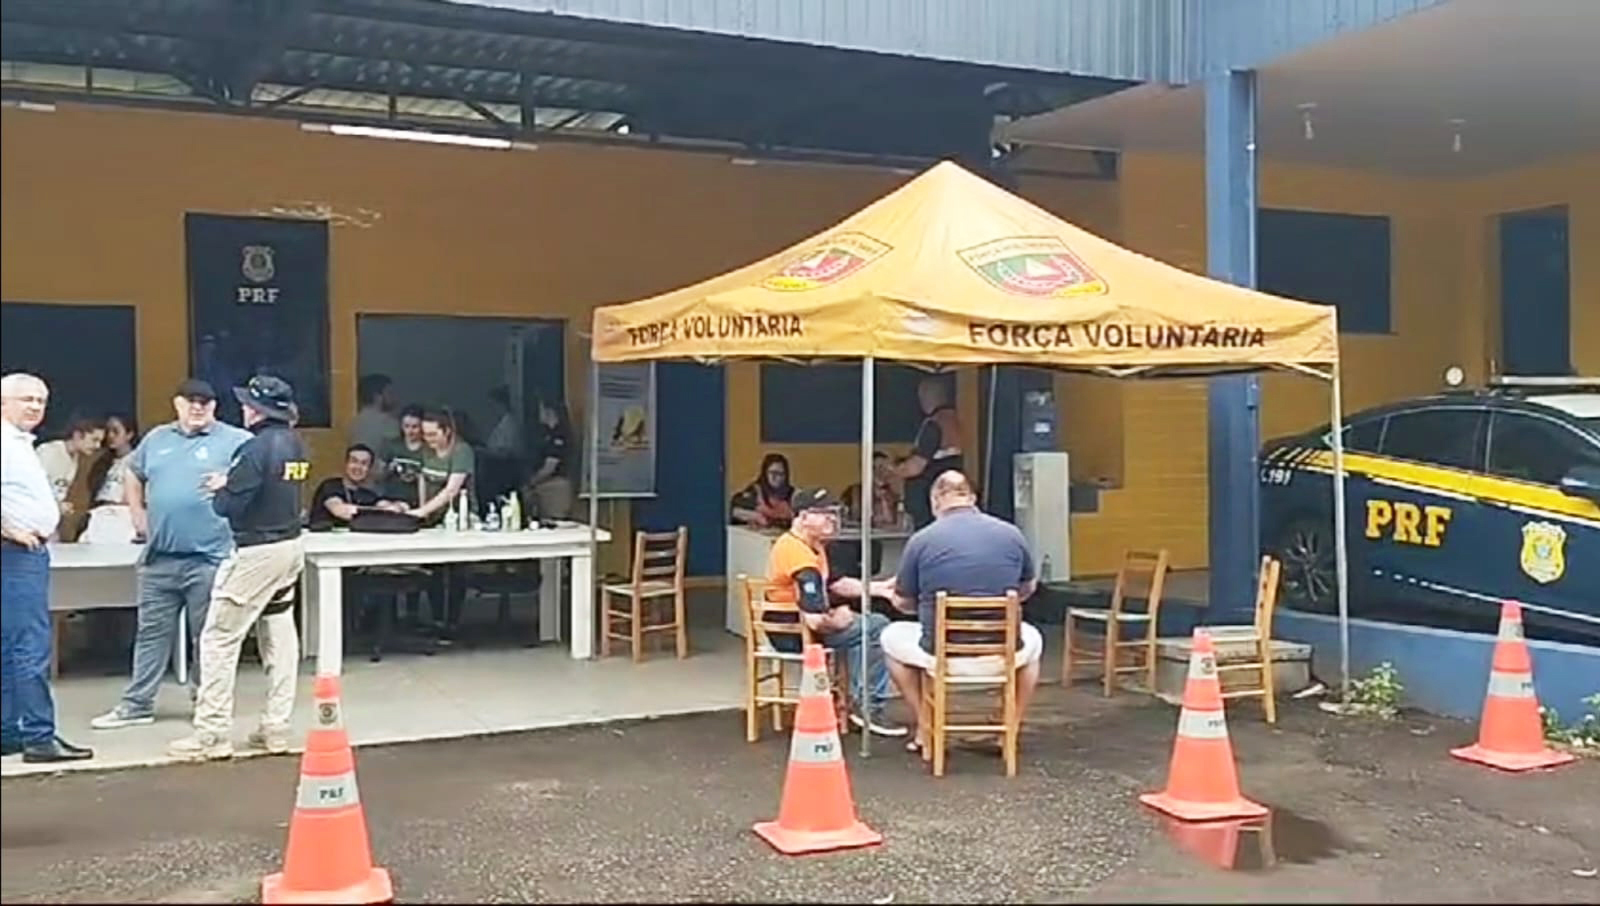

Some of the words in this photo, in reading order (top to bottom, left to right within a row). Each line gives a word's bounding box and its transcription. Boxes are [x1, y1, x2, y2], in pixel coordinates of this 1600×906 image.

[237, 287, 280, 303] PRF
[968, 323, 1073, 351] FORÇA
[1366, 499, 1452, 547] PRF
